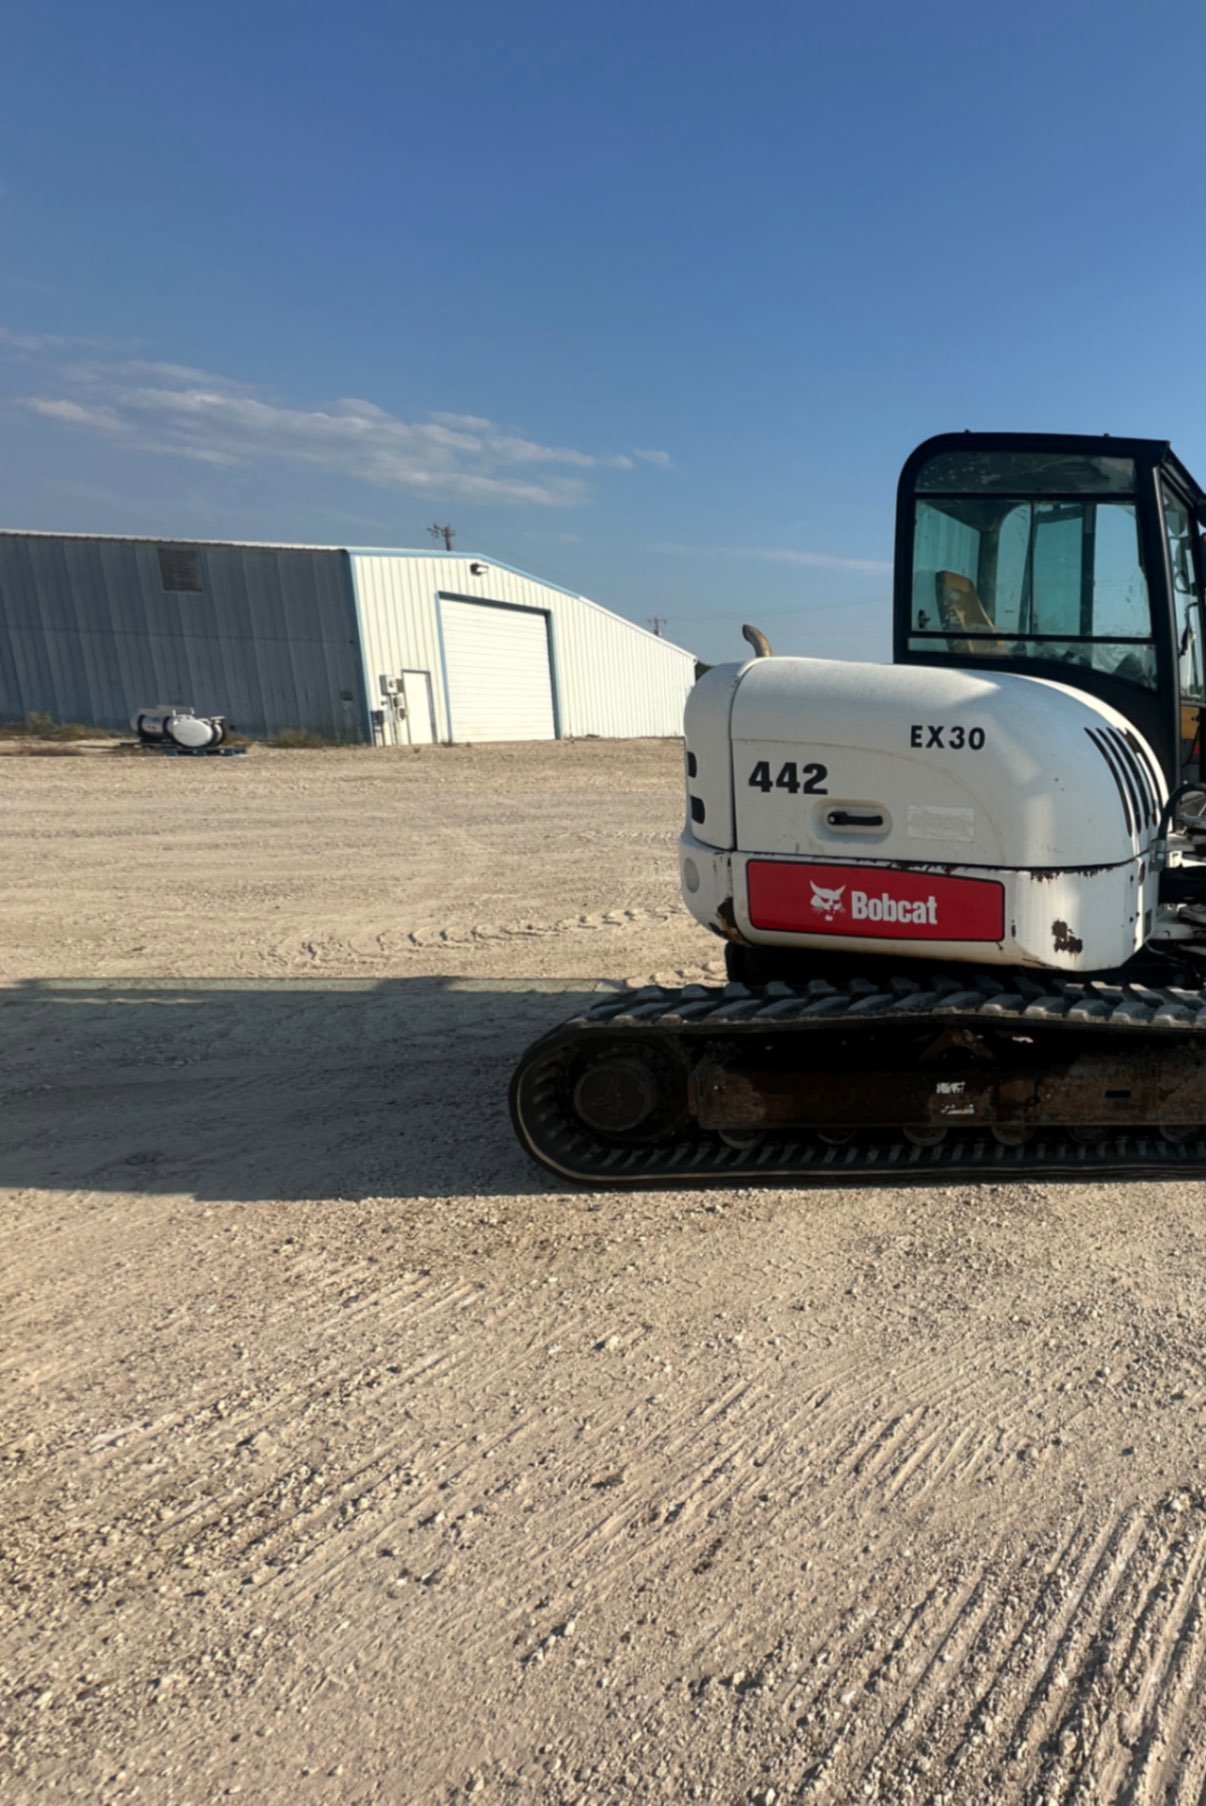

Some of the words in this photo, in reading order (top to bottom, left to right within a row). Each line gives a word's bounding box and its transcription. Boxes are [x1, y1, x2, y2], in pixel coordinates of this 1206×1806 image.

[910, 725, 986, 751] EX30
[748, 761, 829, 795] 442
[851, 890, 938, 926] Bobcat
